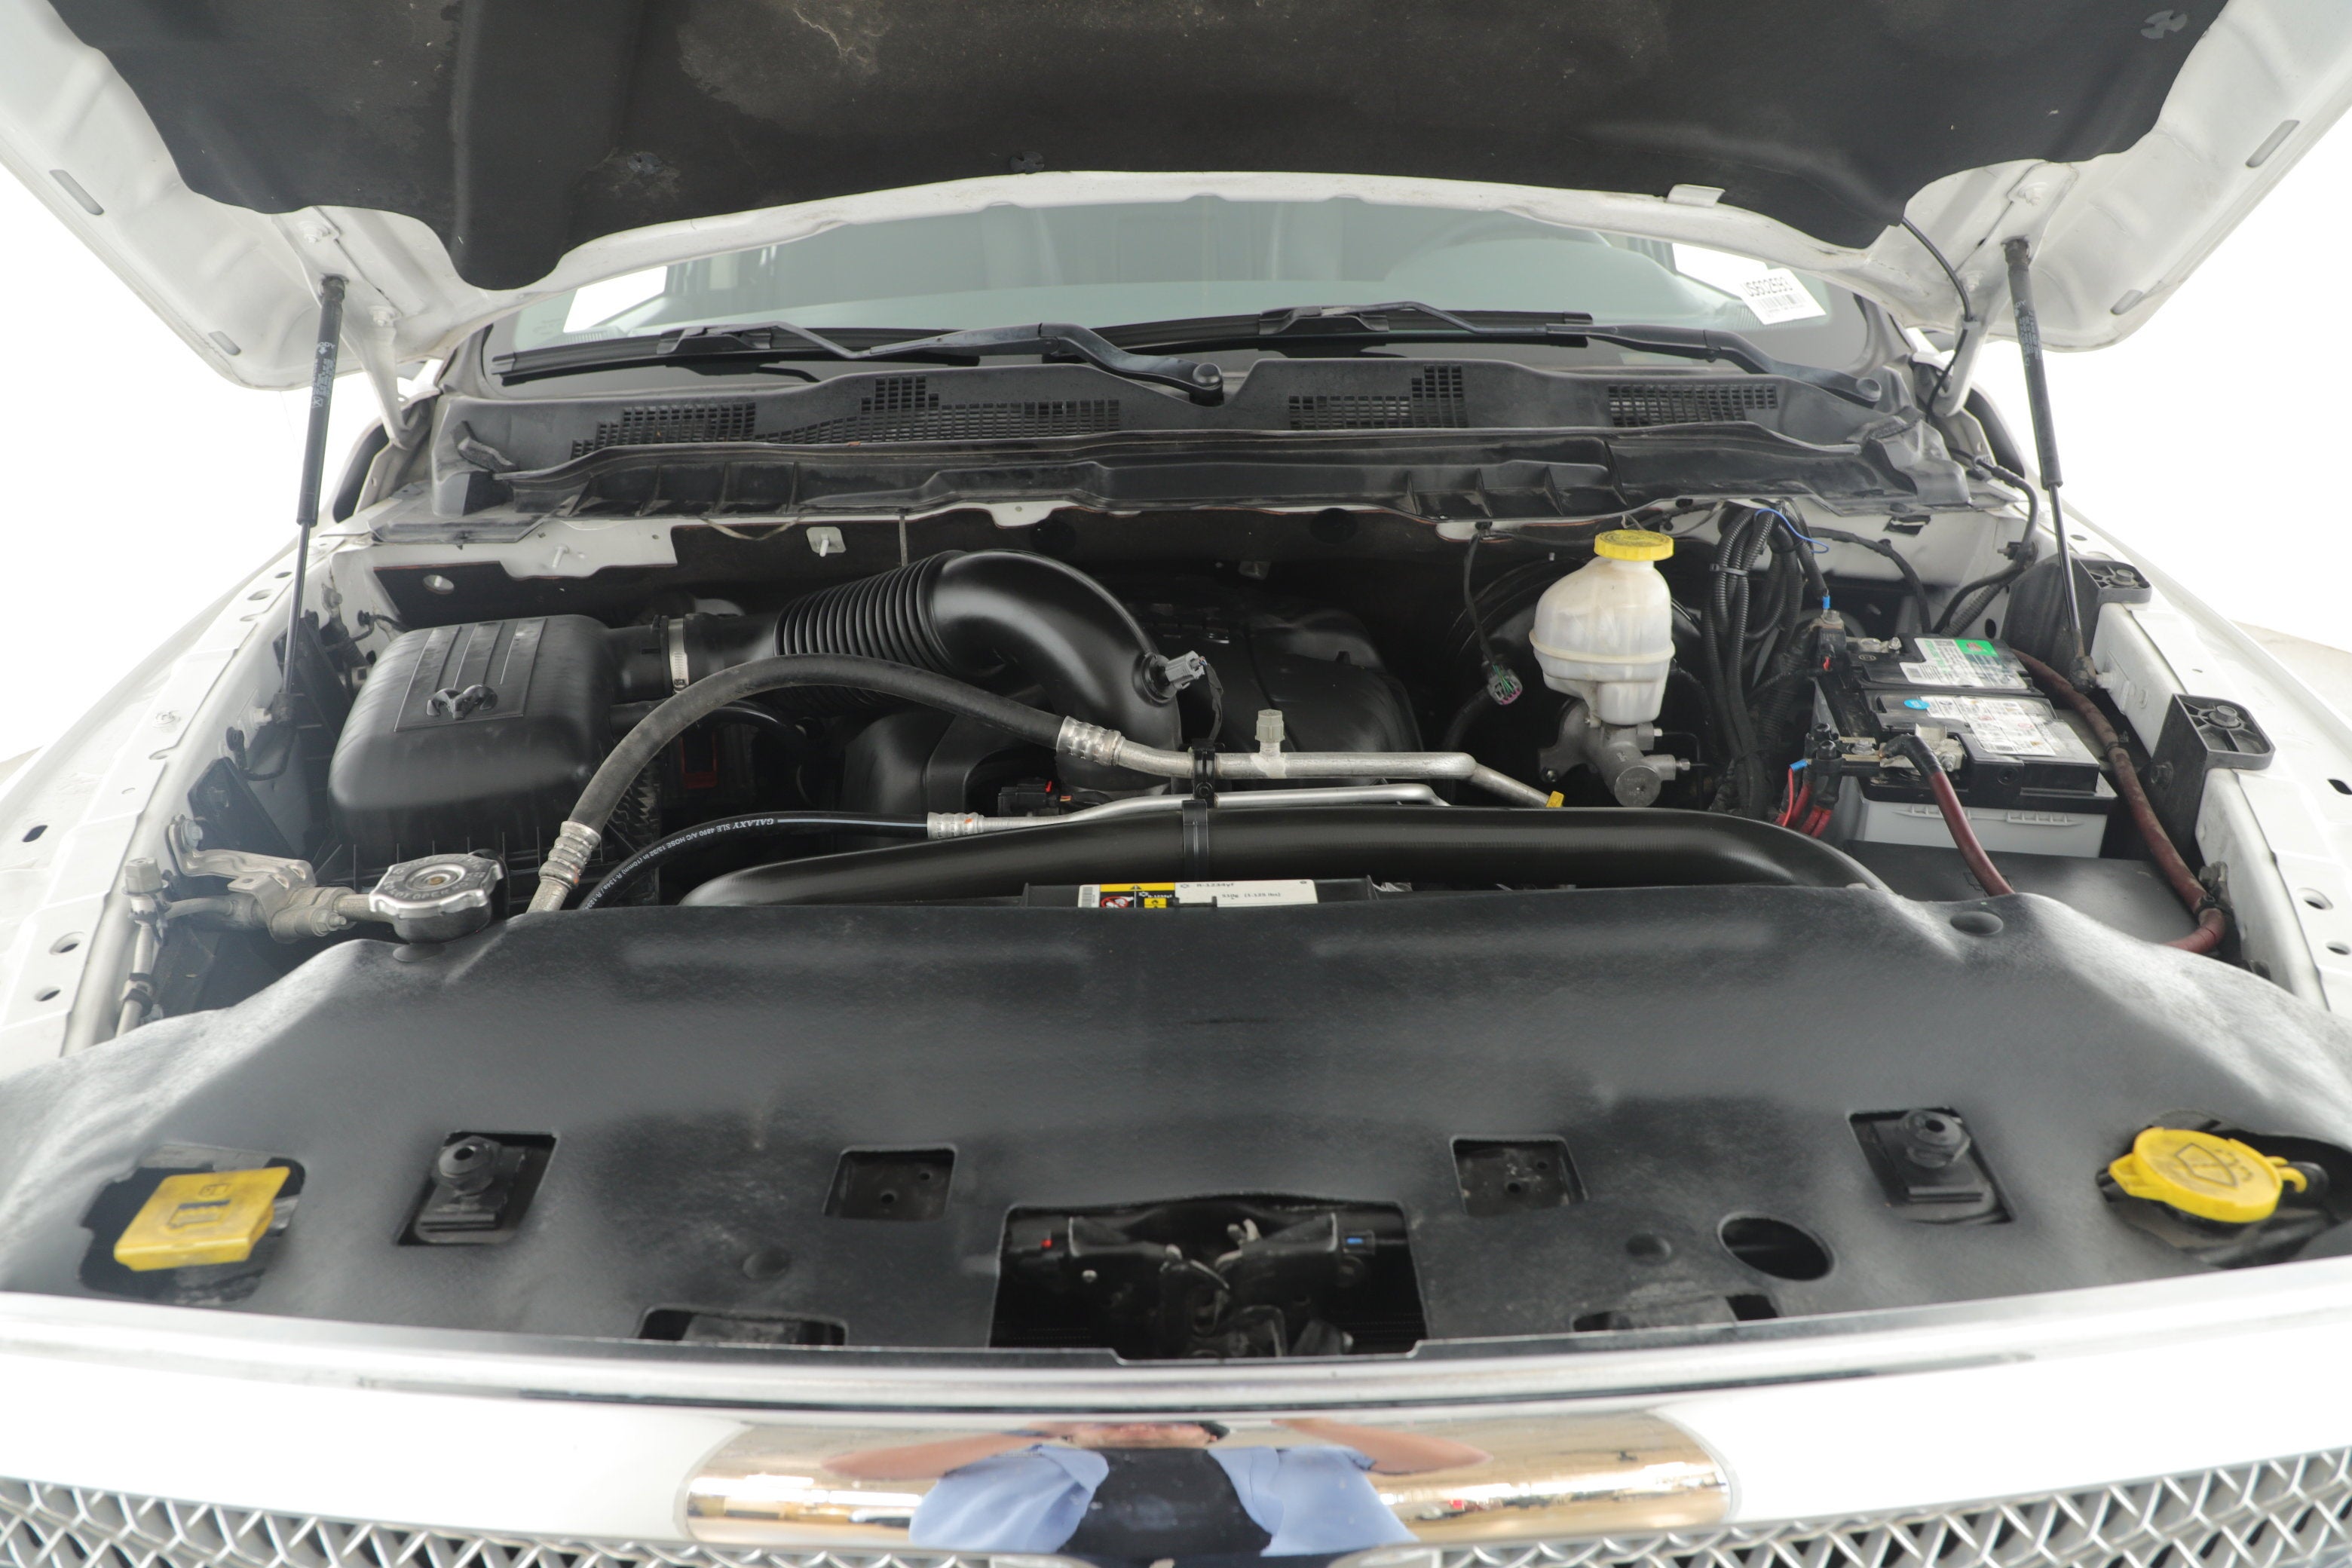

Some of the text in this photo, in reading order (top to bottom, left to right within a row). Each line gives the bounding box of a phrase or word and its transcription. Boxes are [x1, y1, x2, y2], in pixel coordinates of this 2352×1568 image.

[715, 823, 730, 832] SLE
[732, 818, 774, 829] GALAXY
[666, 836, 686, 848] HOSE
[685, 832, 697, 841] A/C
[649, 844, 666, 856] 13/32
[621, 857, 644, 874] (10mm)
